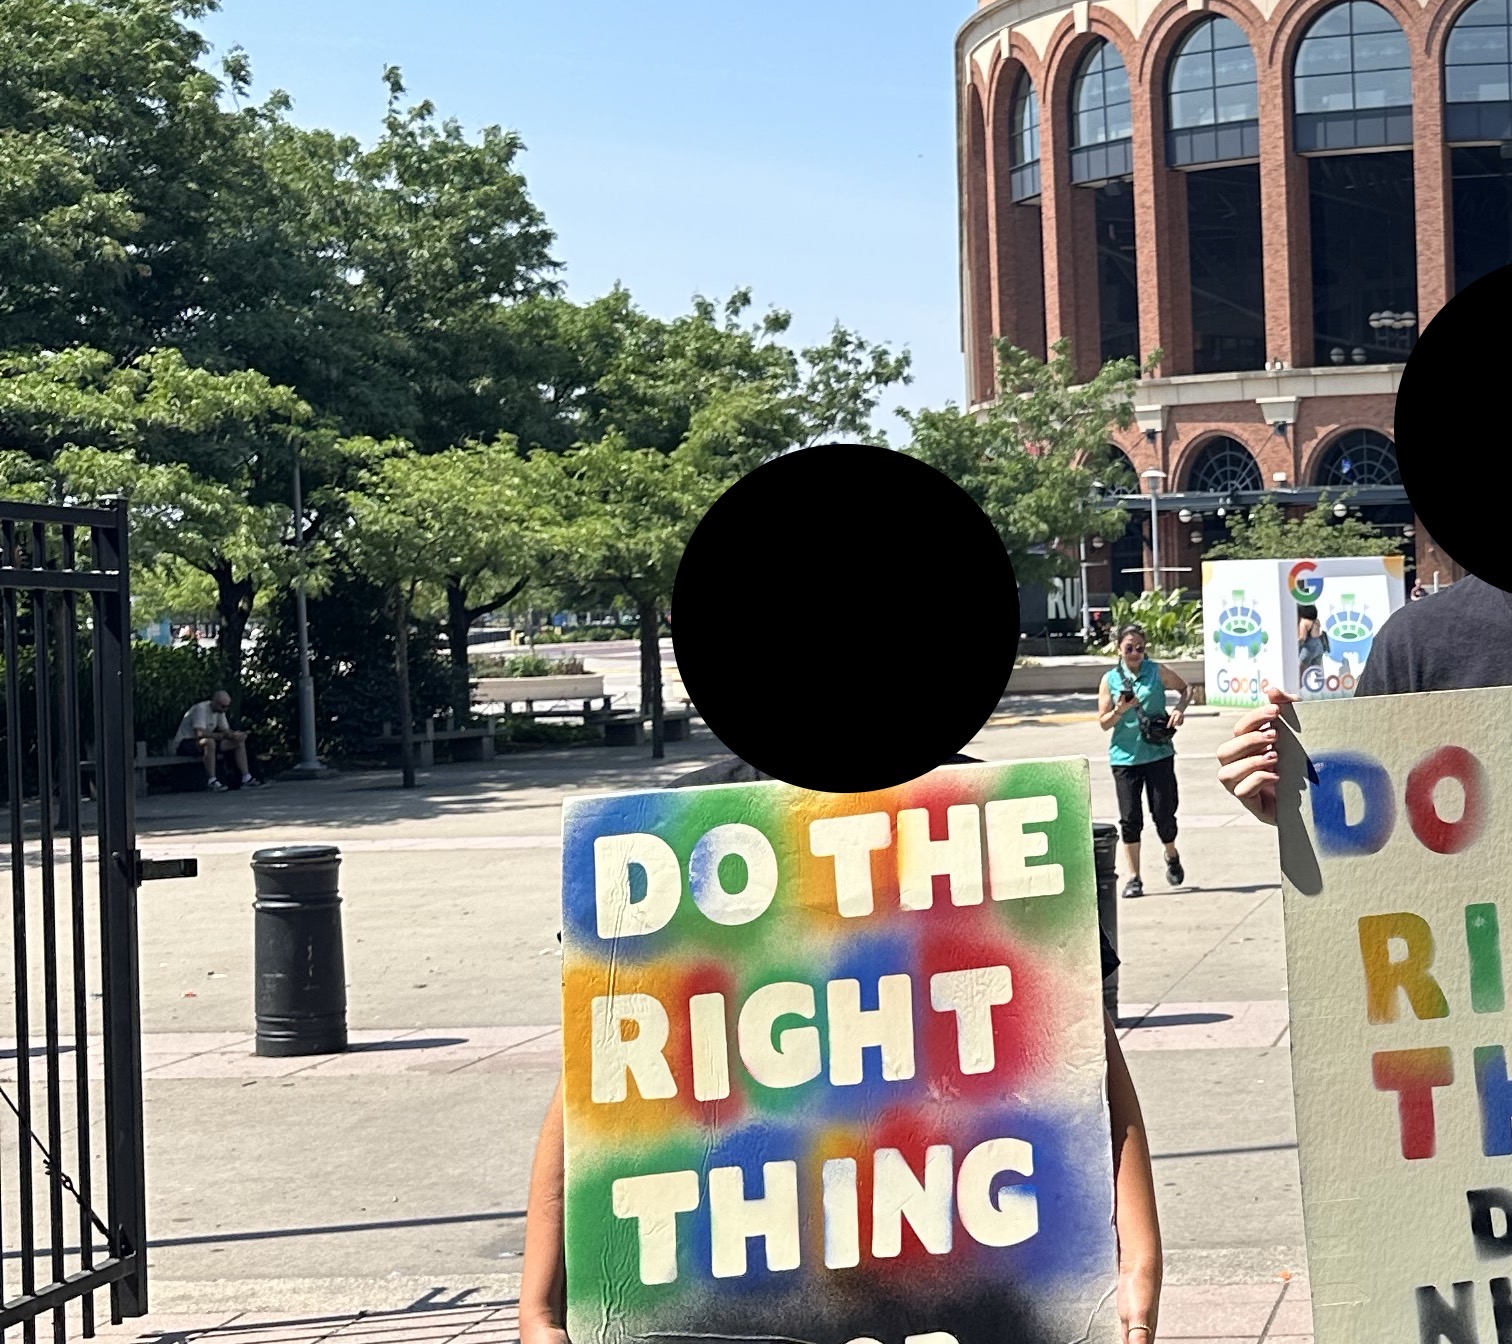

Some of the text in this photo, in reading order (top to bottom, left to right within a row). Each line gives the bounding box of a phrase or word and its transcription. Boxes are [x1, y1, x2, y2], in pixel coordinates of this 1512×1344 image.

[1216, 668, 1270, 702] Google
[1303, 667, 1357, 693] Goo
[1308, 743, 1489, 857] DO
[592, 794, 1066, 941] DO THE
[590, 965, 1014, 1105] RIGHT
[611, 1137, 1040, 1287] THING
